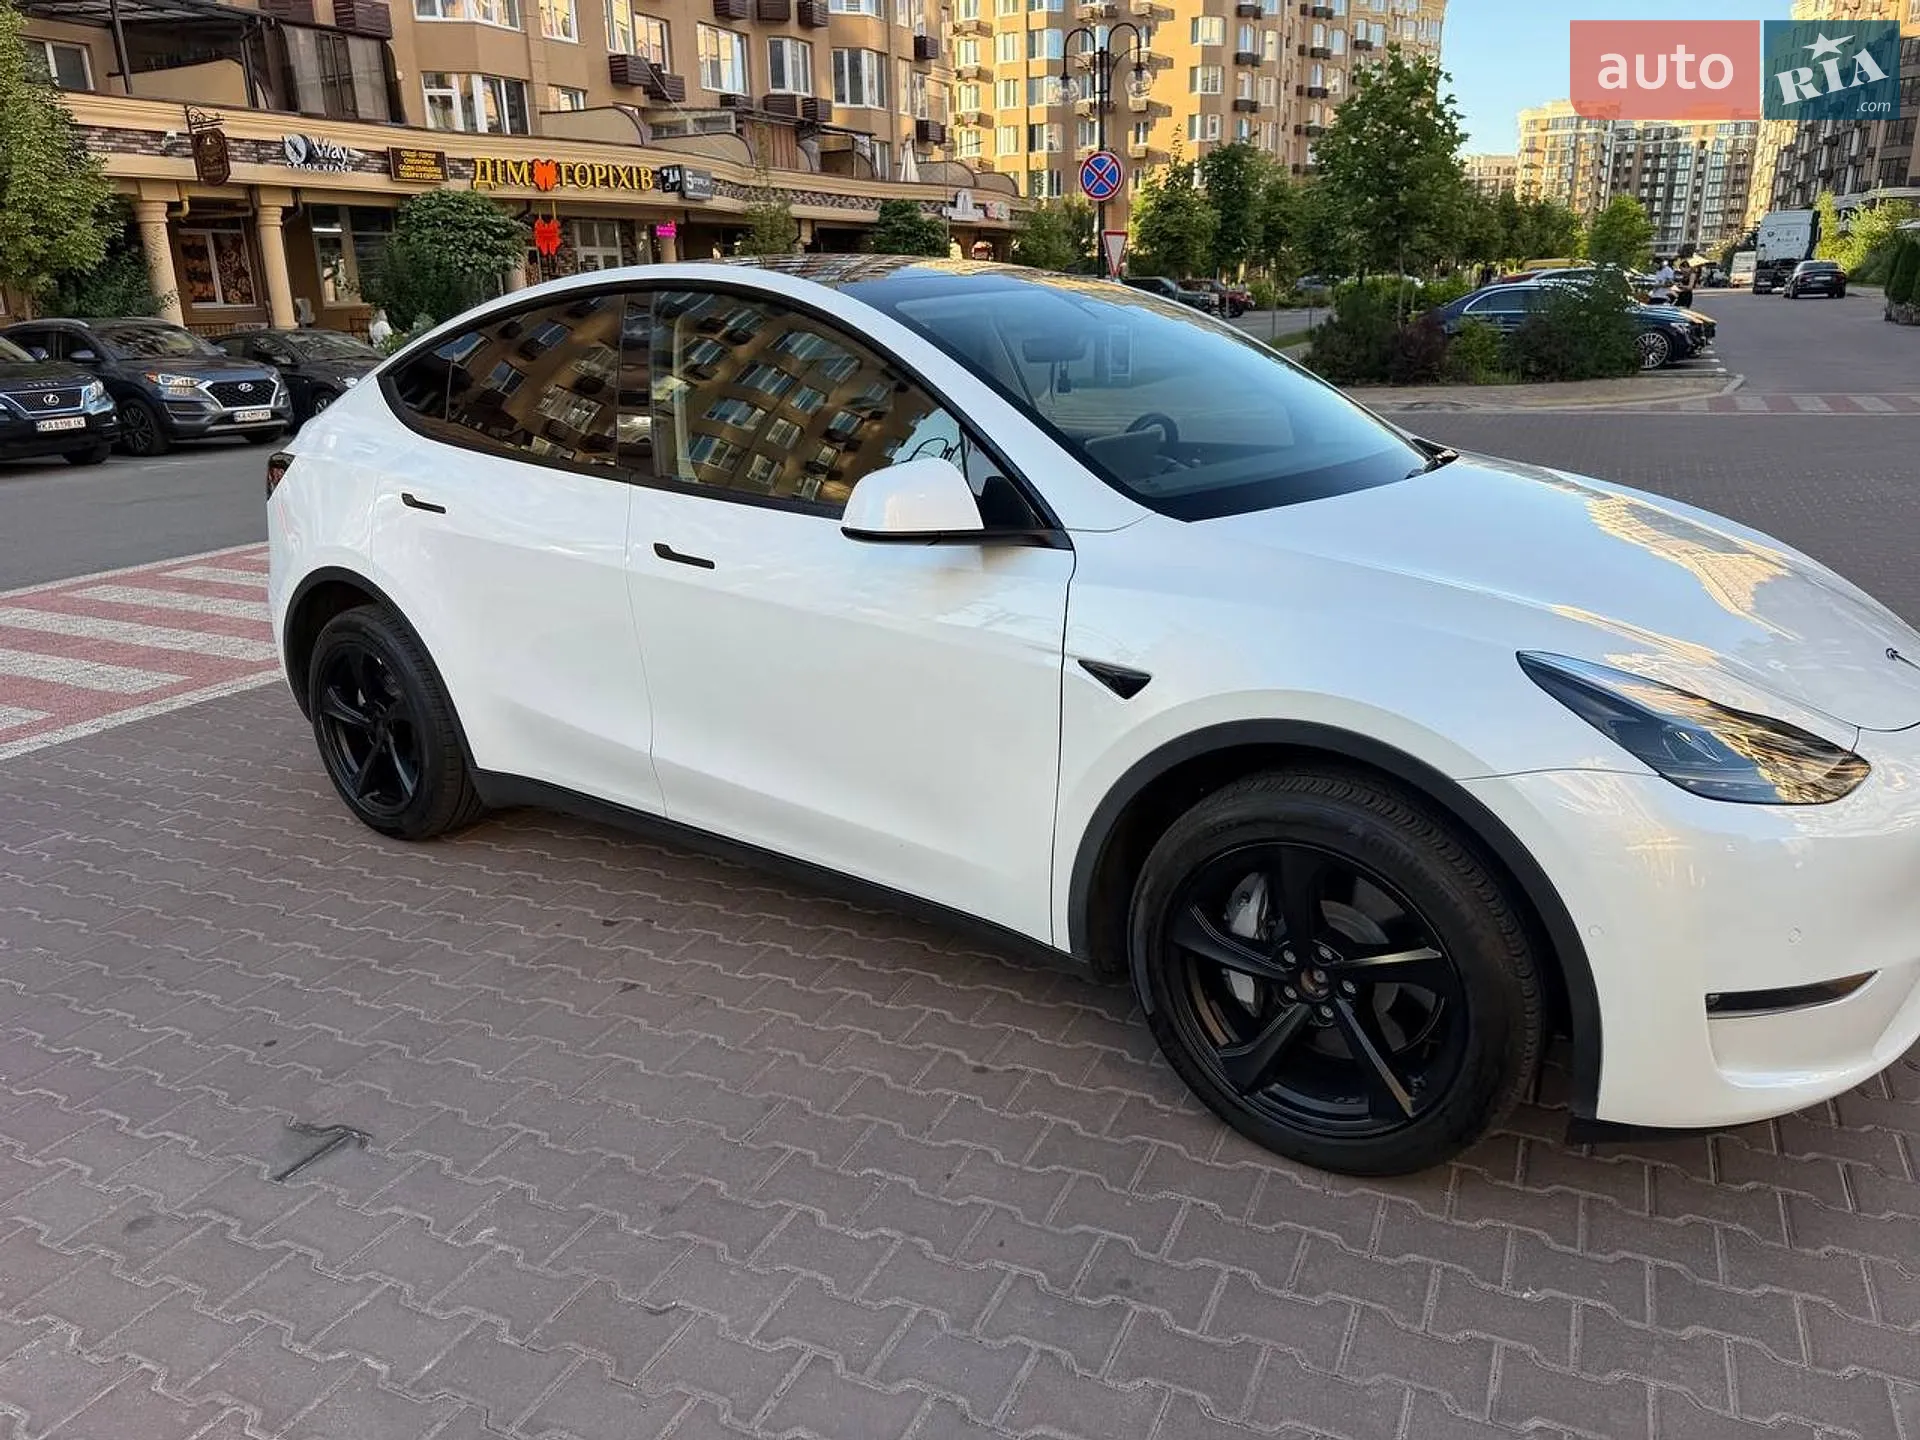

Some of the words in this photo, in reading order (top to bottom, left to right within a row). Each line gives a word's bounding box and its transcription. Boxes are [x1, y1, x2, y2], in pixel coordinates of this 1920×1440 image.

[312, 137, 348, 167] Way
[472, 158, 530, 190] ДІМ
[559, 162, 654, 191] ГОРІХІВ
